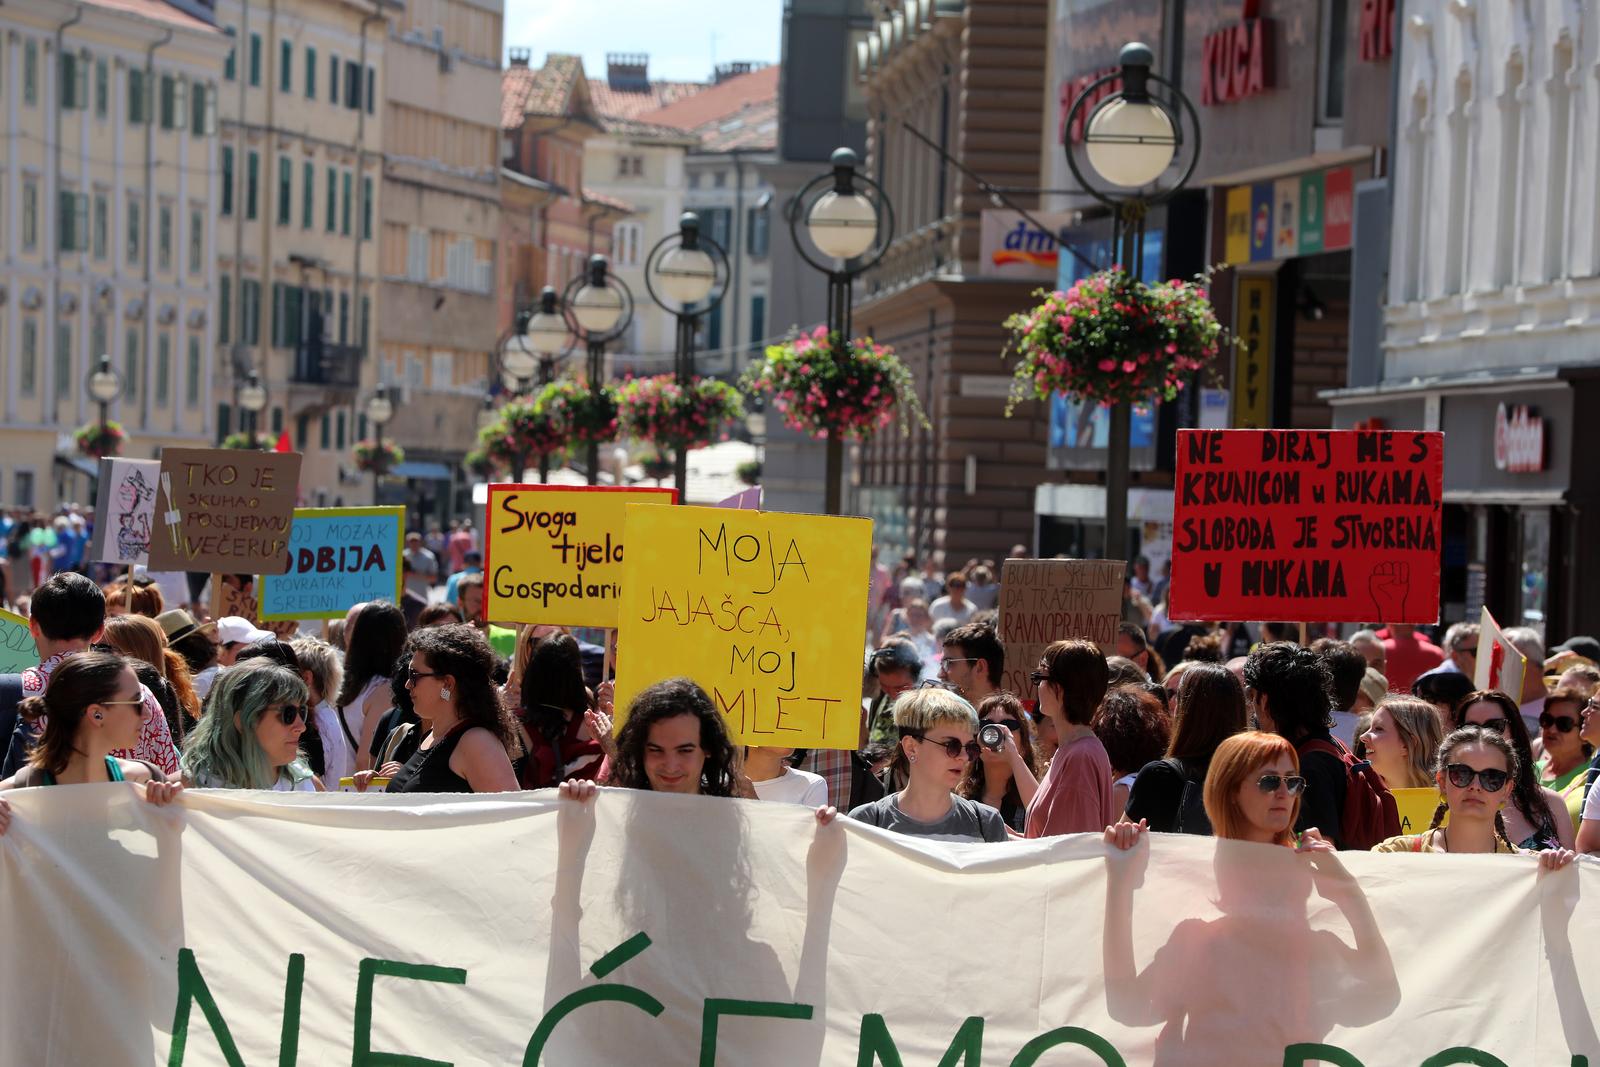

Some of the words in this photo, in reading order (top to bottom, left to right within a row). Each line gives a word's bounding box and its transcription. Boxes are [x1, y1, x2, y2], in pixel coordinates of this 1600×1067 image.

[1005, 220, 1053, 251] dm
[1247, 289, 1261, 411] HAPPY
[1188, 432, 1223, 464] NE
[1262, 432, 1331, 469] DIRAJ
[1357, 432, 1394, 463] ME
[1408, 433, 1428, 463] S
[182, 462, 238, 487] TKO
[250, 467, 276, 490] JE
[1183, 471, 1300, 506] KRUNICOM
[1336, 470, 1440, 512] RUKAMA,
[188, 493, 260, 509] SKUHAO
[501, 495, 577, 538] Svoga
[185, 533, 287, 560] VEČERU?
[290, 523, 313, 543] OJ
[1177, 516, 1276, 553] SLOBODA
[1293, 516, 1317, 548] JE
[1331, 514, 1436, 550] STVORENA
[698, 522, 810, 594] MOJA
[1006, 562, 1055, 588] BUDITE
[273, 574, 345, 593] POVRATAK
[361, 575, 373, 589] U
[493, 565, 622, 608] Gospodari
[1204, 563, 1222, 597] U
[1241, 560, 1347, 597] MUKAMA
[641, 585, 791, 644] JAJAŠCA,
[1006, 589, 1024, 609] DA
[1004, 611, 1120, 645] RAVNOPRAVNOST
[730, 644, 797, 692] MOJ
